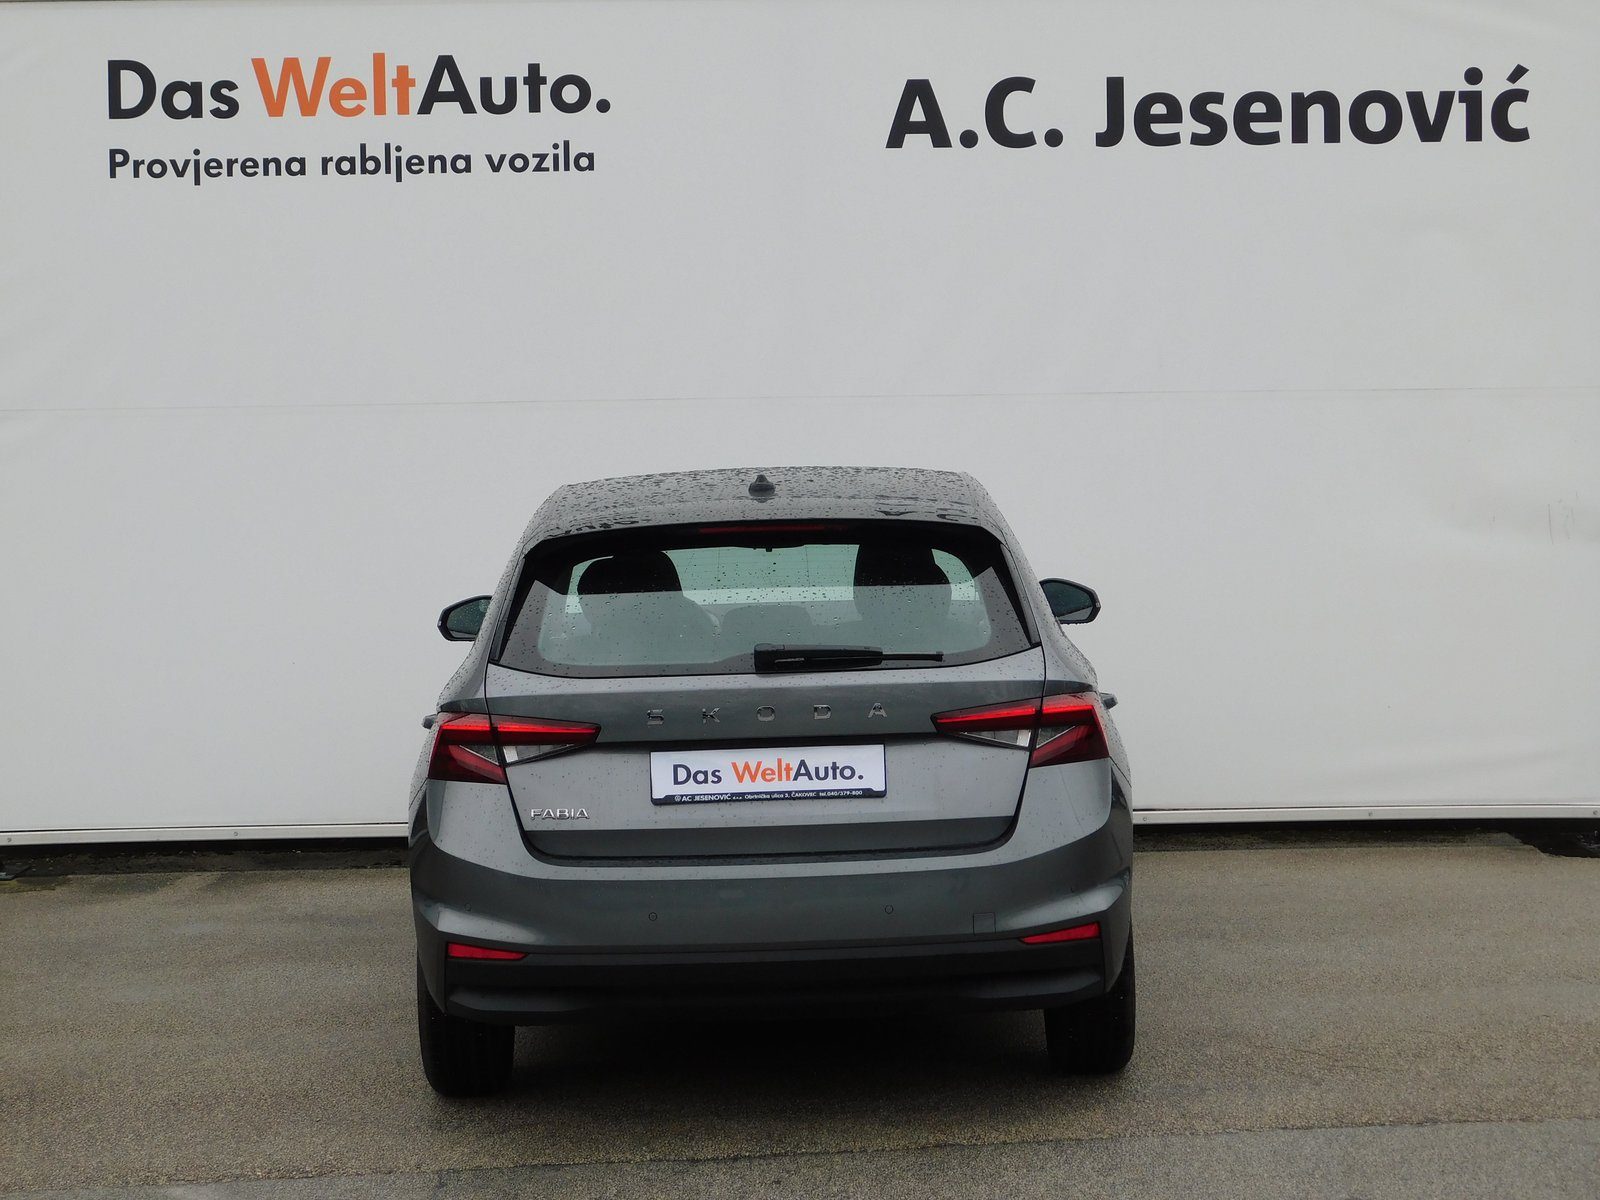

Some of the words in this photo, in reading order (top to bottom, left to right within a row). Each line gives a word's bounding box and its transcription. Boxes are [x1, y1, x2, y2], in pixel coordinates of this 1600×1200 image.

[108, 60, 240, 119] Das
[252, 53, 611, 117] WeltAuto.
[886, 77, 1064, 149] A.C.
[1096, 64, 1531, 147] Jesenović
[108, 148, 307, 186] Provjerena
[321, 143, 472, 183] rabljena
[485, 140, 595, 174] vozila
[672, 763, 722, 785] Das
[731, 757, 864, 784] WeltAuto.
[530, 807, 590, 820] FABIA
[693, 793, 731, 802] JESENOVIĆ
